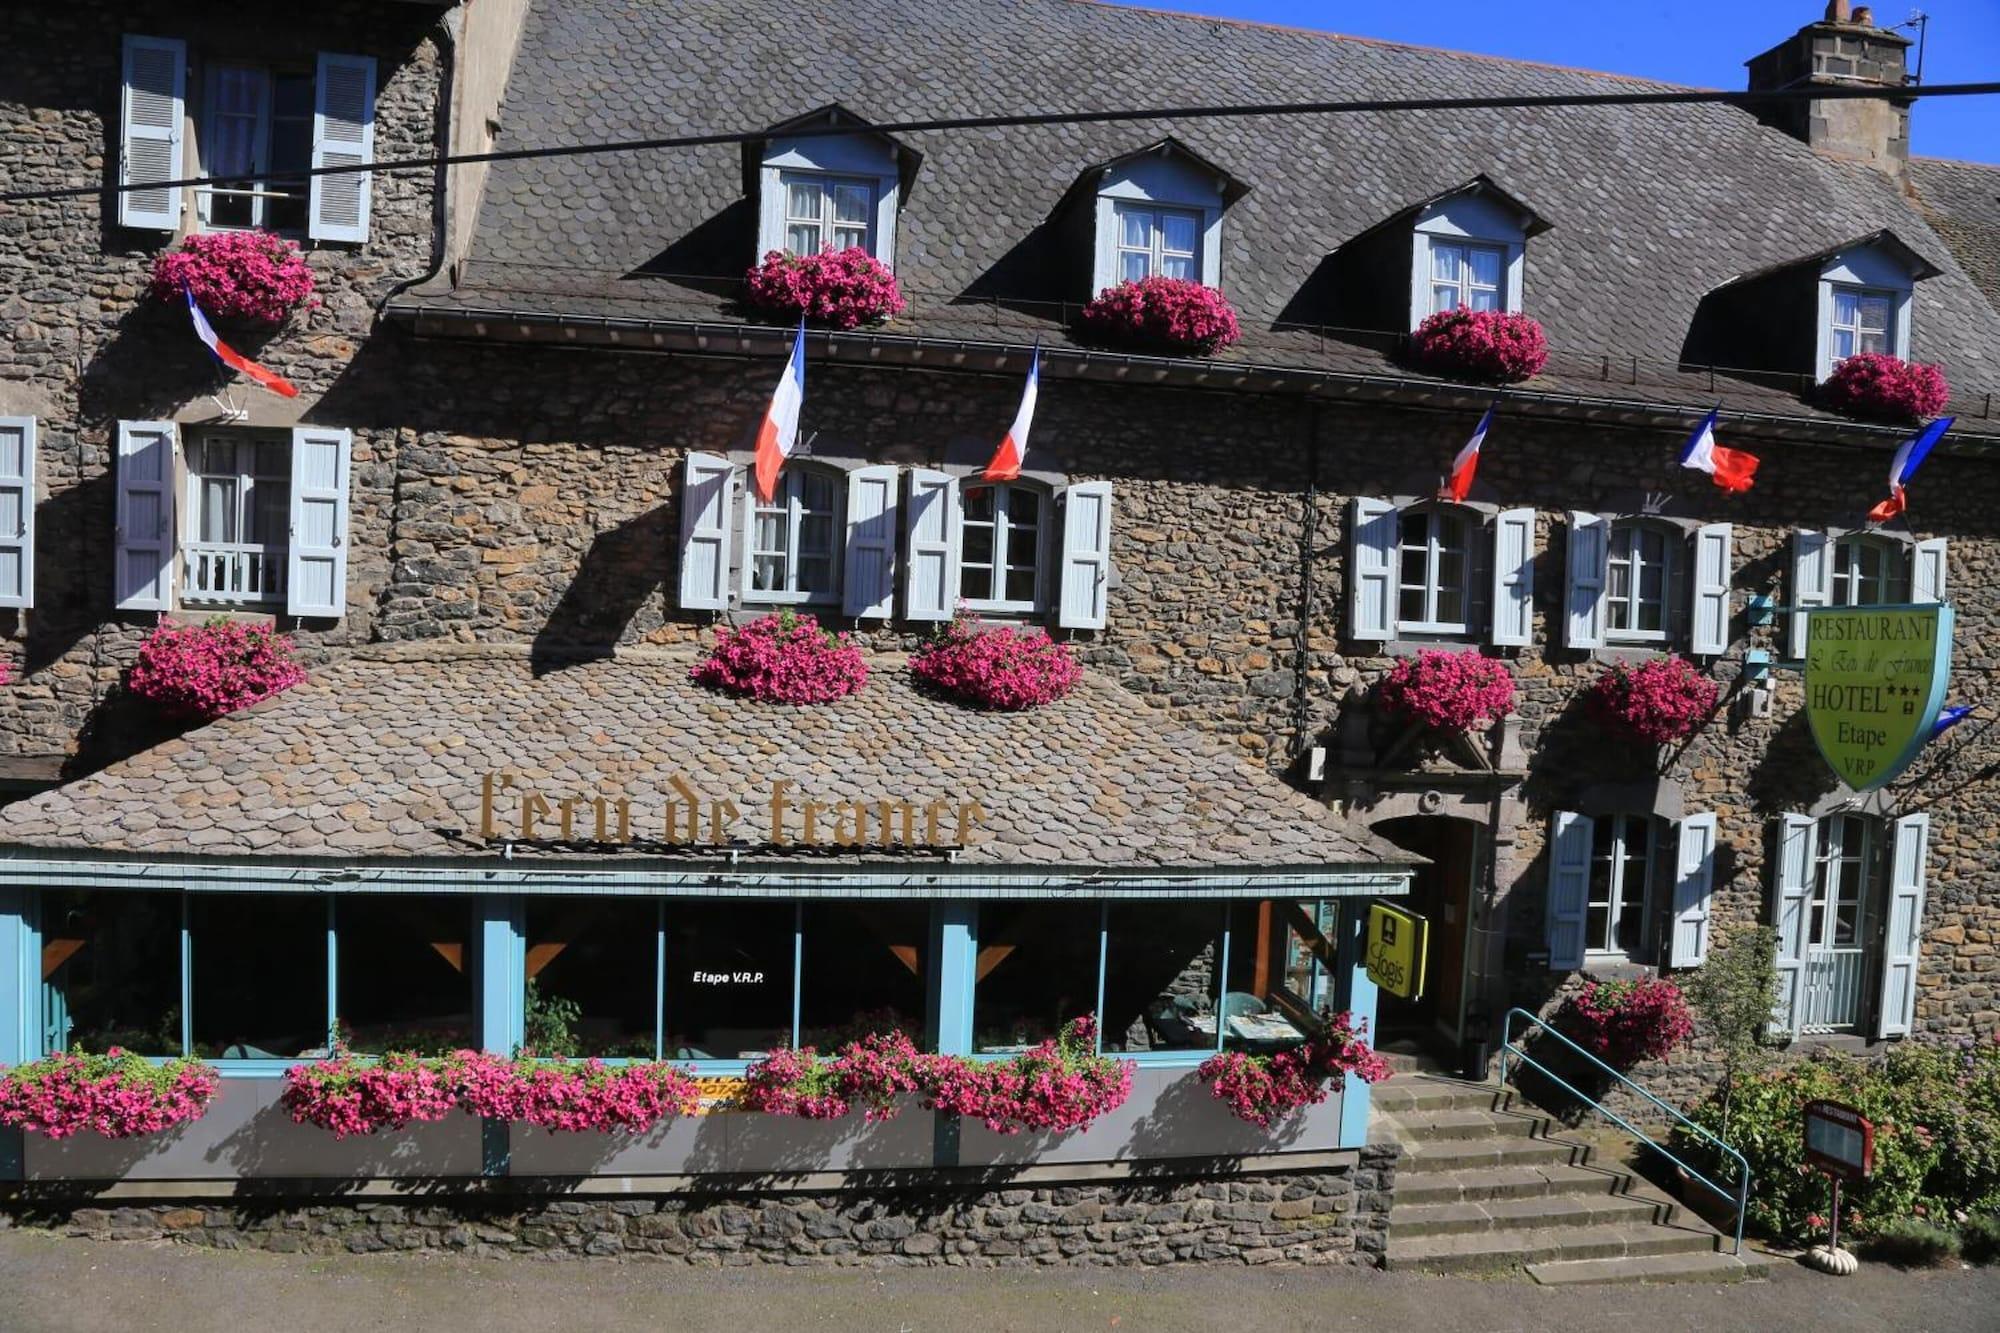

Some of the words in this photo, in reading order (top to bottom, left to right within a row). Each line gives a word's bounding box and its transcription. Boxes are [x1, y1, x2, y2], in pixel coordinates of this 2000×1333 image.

[1812, 615, 1935, 641] RESTAURANT
[1813, 683, 1888, 714] HOTEL
[1838, 721, 1887, 751] Etape
[1844, 756, 1875, 777] VRP
[665, 771, 741, 846] de
[768, 777, 987, 847] france
[693, 971, 730, 986] Etape
[1367, 942, 1404, 989] Logis
